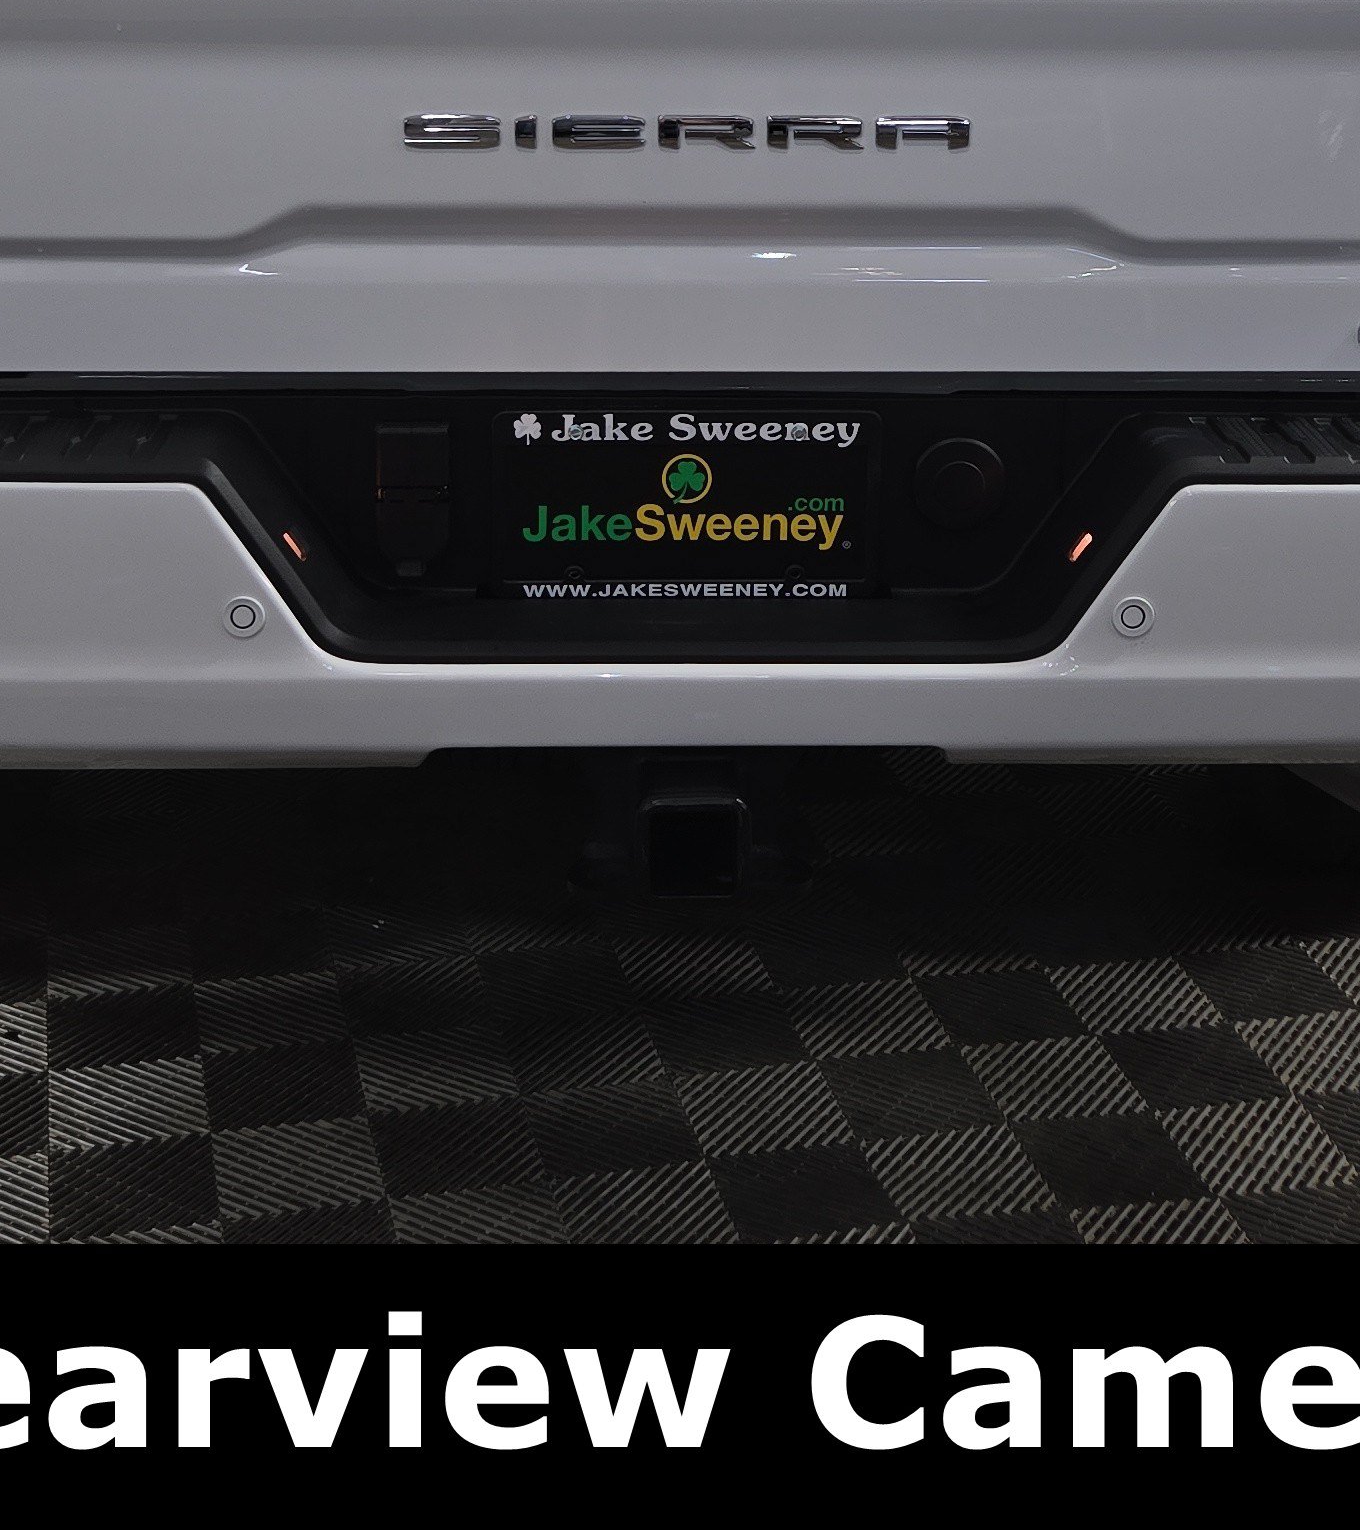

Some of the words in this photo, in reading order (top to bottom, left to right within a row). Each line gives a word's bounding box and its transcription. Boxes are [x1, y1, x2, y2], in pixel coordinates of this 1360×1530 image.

[402, 114, 972, 150] SIERRA
[551, 414, 654, 442] Jake
[669, 414, 861, 448] Sweeney
[523, 583, 848, 598] WWW.JAKESWEENEY.COM
